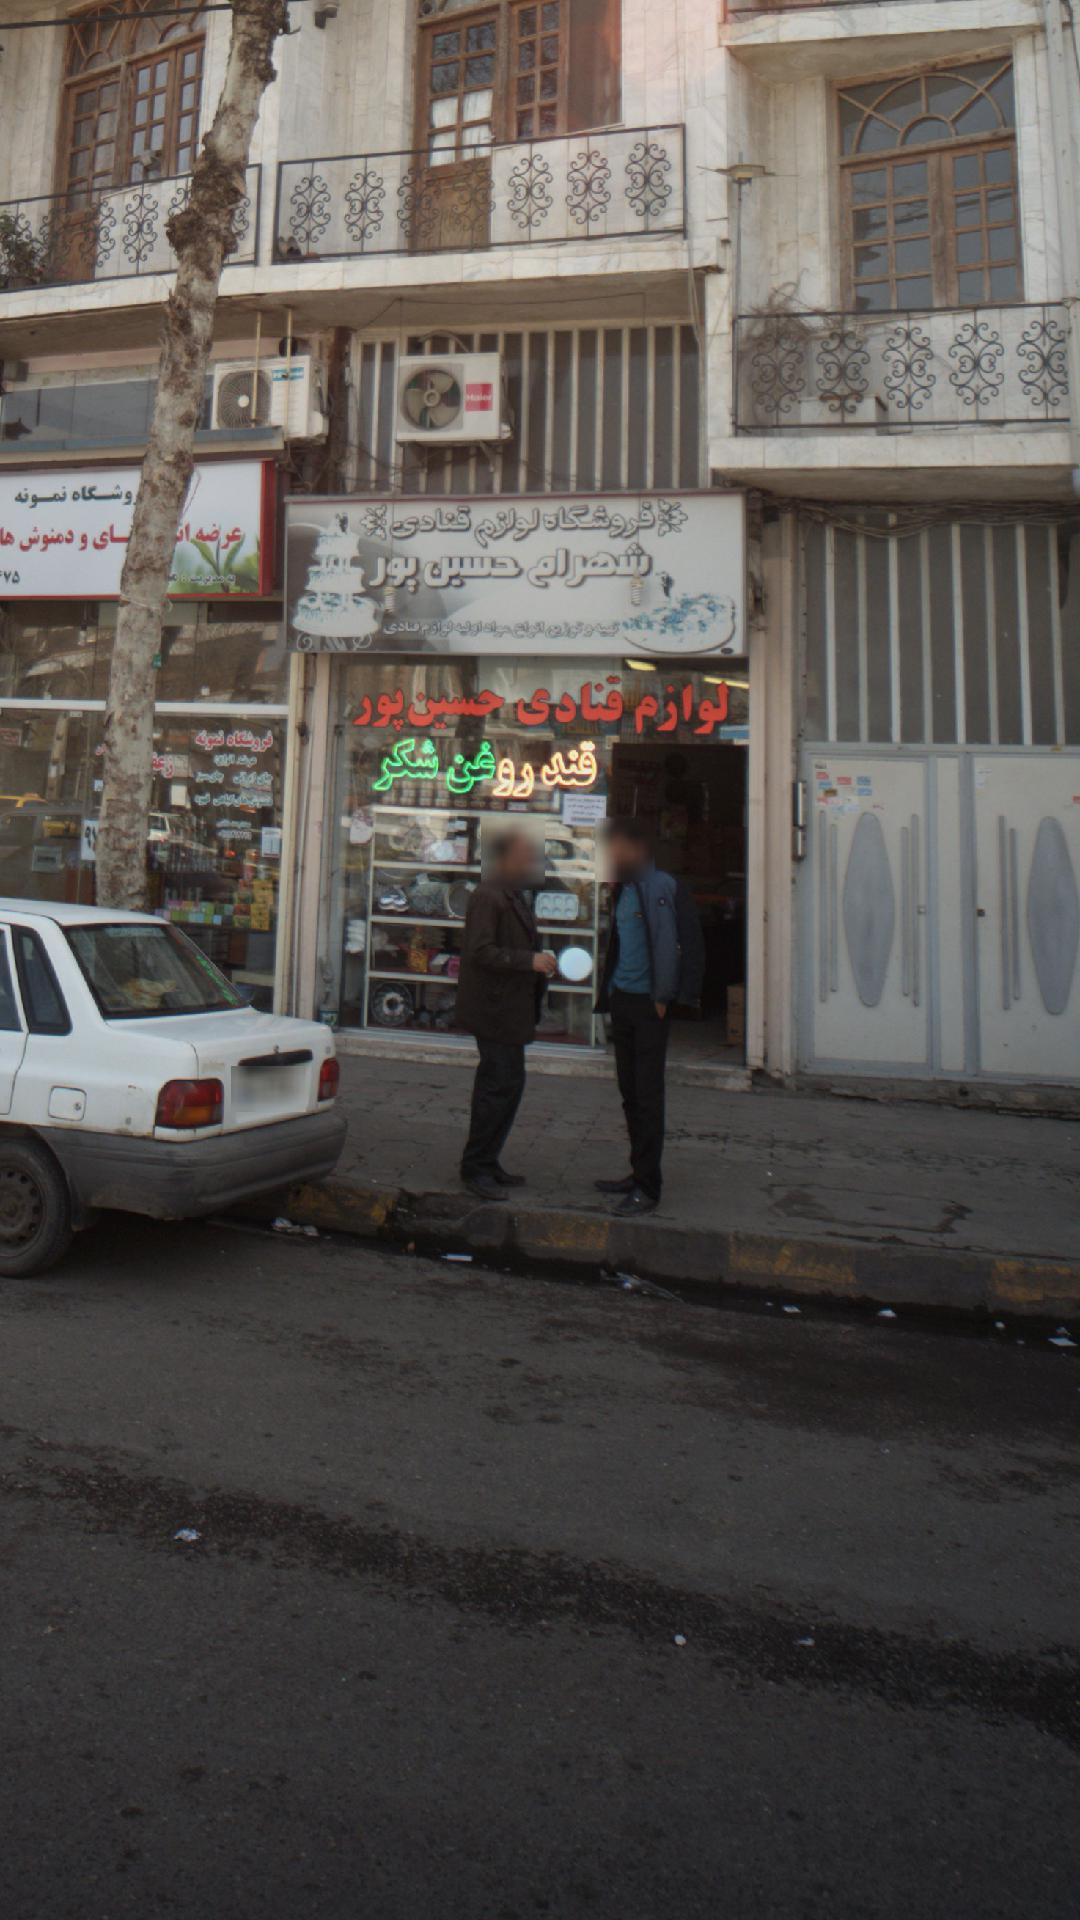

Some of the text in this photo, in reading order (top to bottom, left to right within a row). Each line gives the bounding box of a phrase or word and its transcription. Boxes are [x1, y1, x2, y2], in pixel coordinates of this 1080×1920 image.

[14, 484, 137, 509] وشگاه نمونه
[195, 523, 241, 550] عرضه
[390, 501, 655, 549] فروشگاه لوازم قنادی
[19, 526, 75, 552] دمنوش
[79, 532, 88, 552] و
[369, 542, 653, 594] شهرام حسین پور
[383, 621, 420, 635] قنادی
[353, 675, 729, 734] لوازم قنادی حسین پور
[195, 730, 273, 752] فروشگاه نمونه
[373, 738, 598, 798] قند روغن شکر
